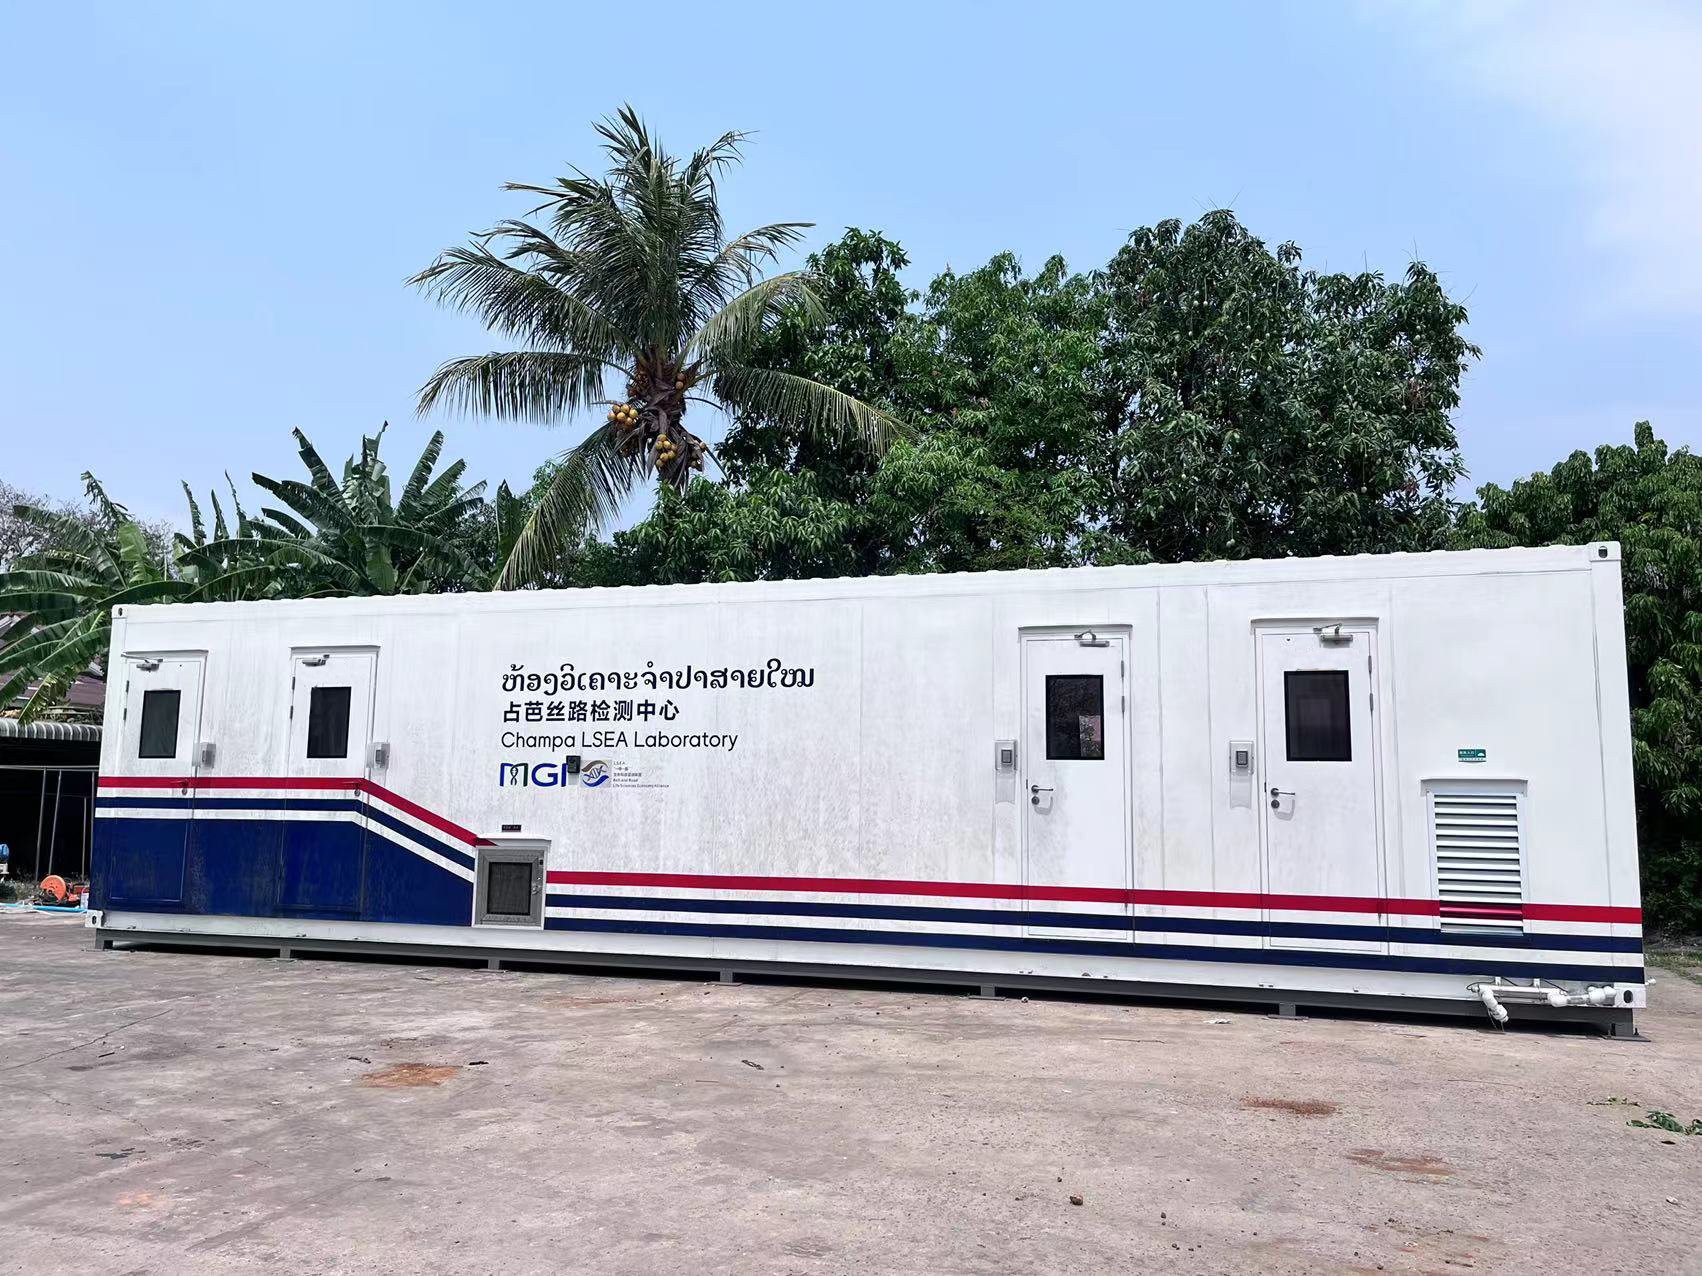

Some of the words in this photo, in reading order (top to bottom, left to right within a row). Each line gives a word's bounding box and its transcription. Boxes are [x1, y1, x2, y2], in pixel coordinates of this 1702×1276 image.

[503, 699, 680, 723] 占芭丝路检测中心
[501, 731, 576, 752] Champa
[581, 730, 629, 748] LSEA
[634, 730, 739, 752] Laboratory
[499, 762, 568, 788] MGI
